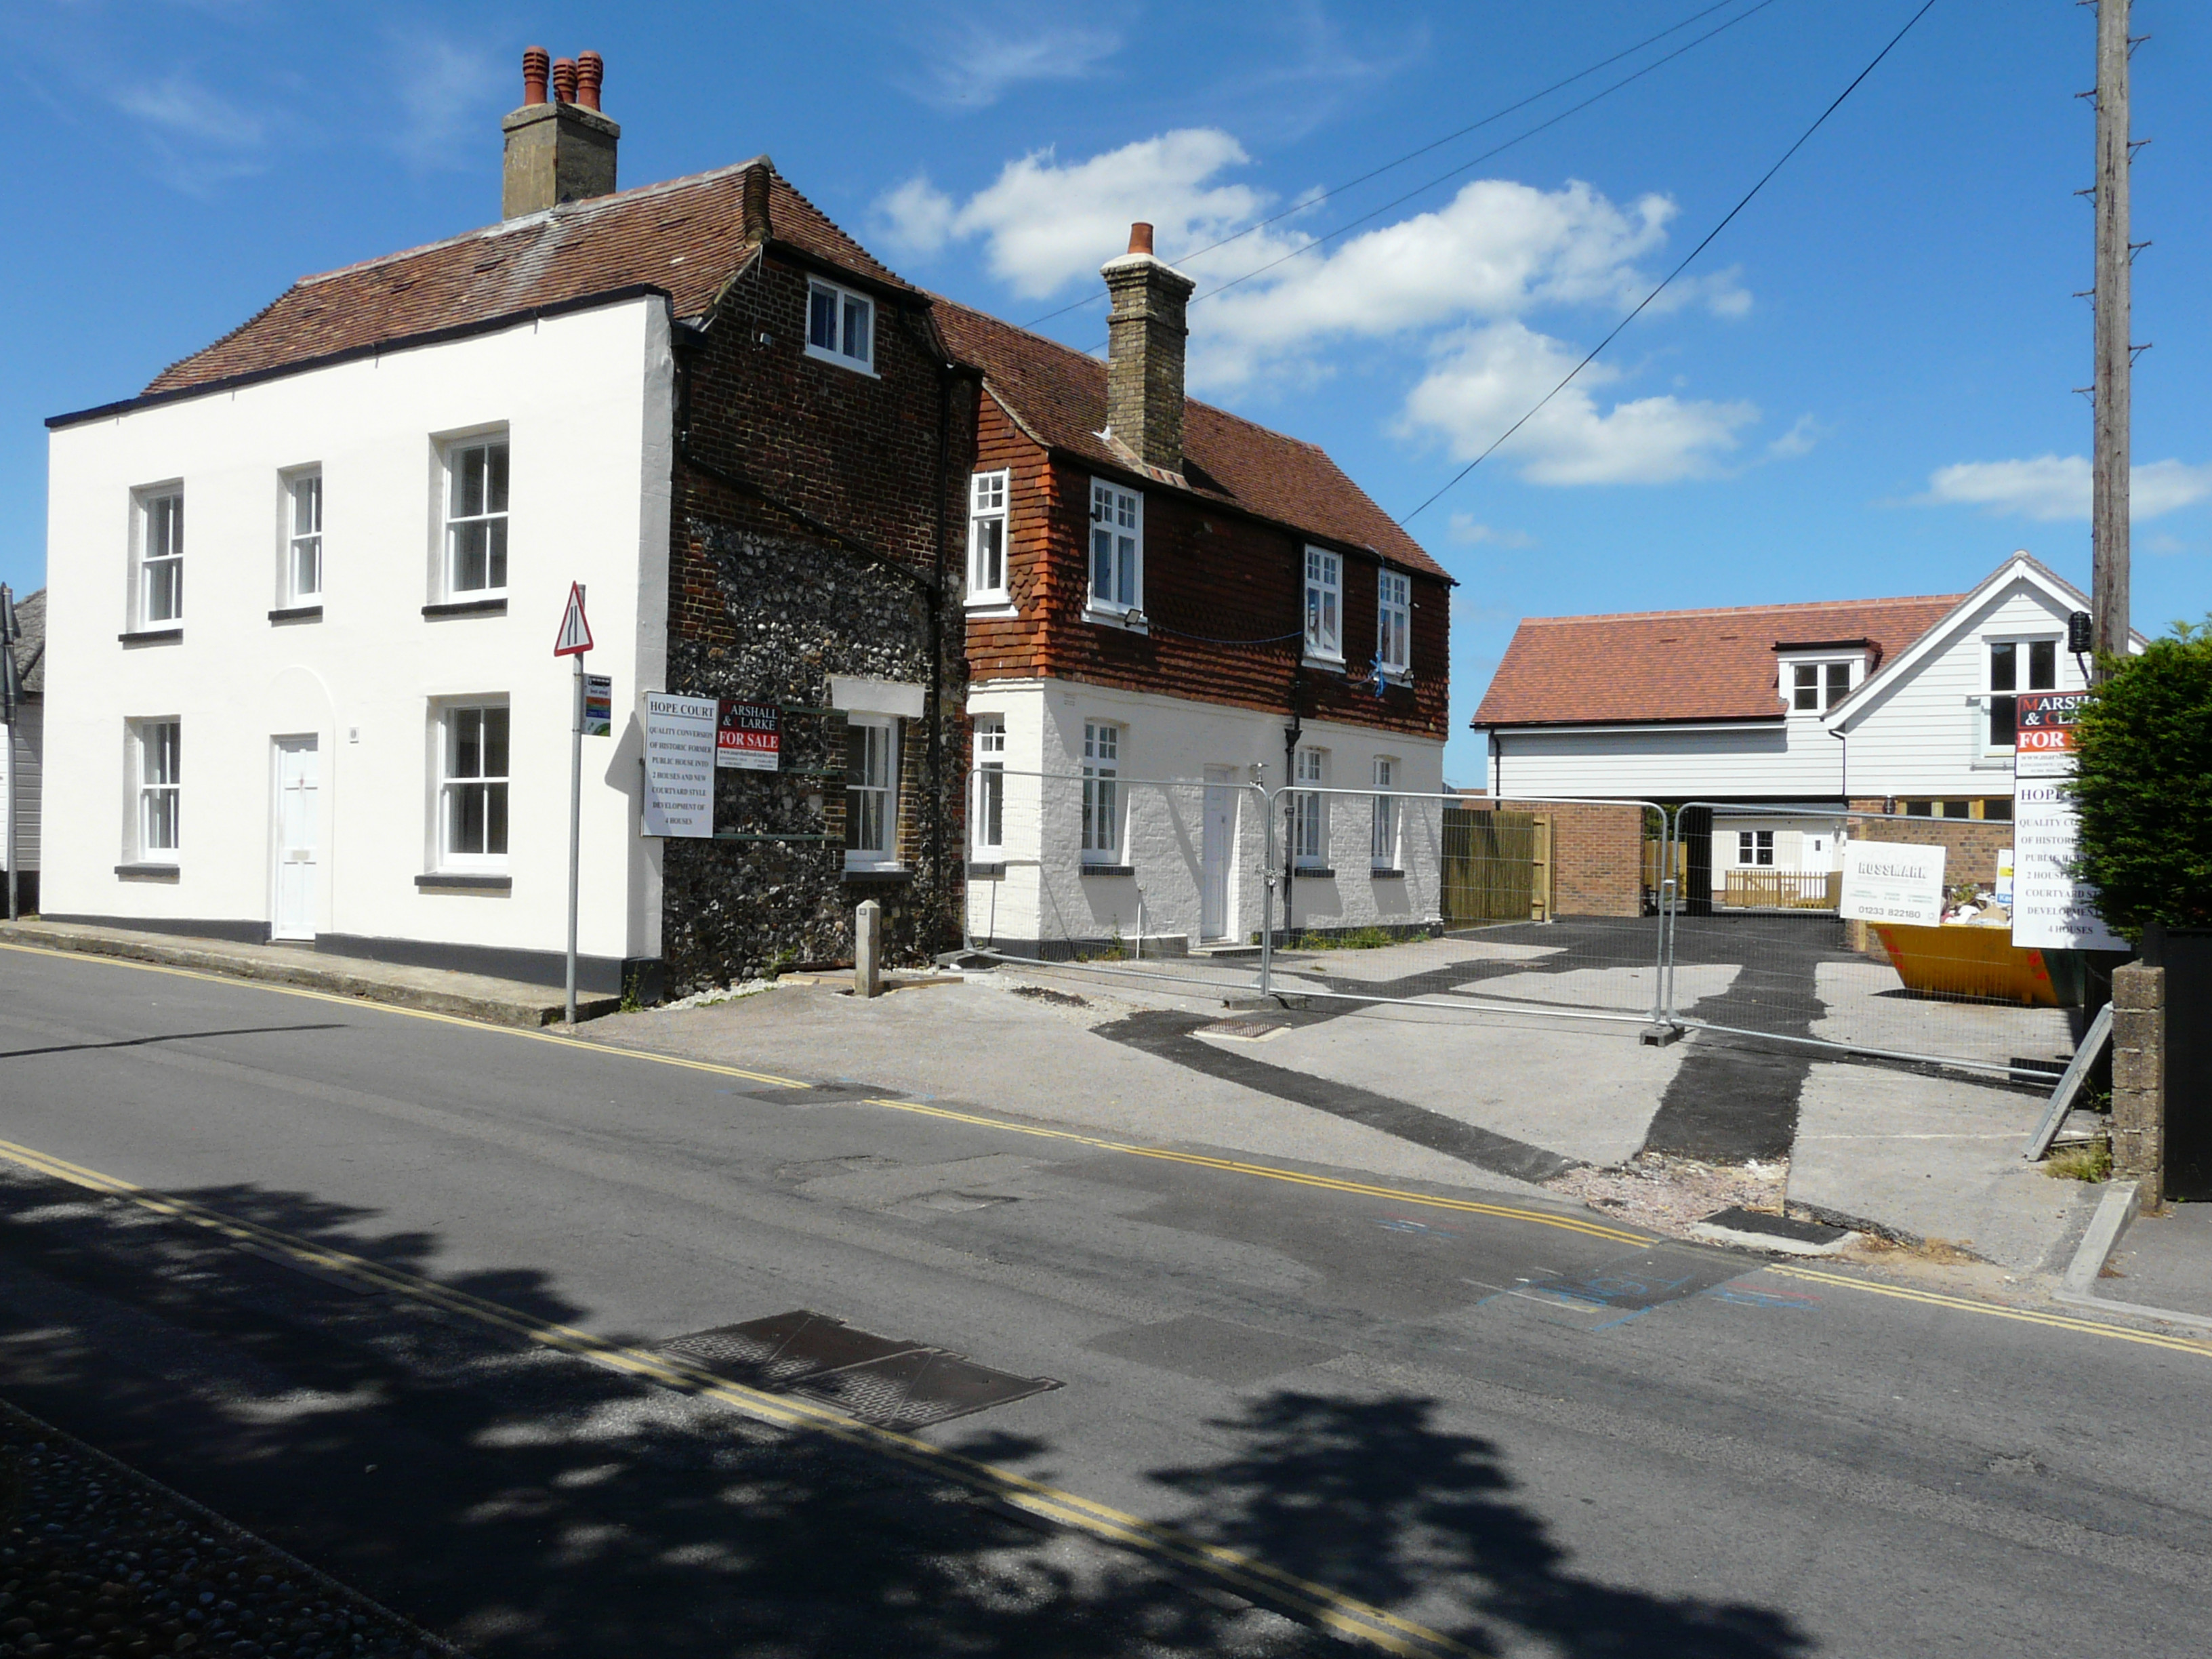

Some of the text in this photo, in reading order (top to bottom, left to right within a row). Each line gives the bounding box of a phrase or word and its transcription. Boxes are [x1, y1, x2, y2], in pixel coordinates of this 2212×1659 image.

[2022, 695, 2100, 711] MARSH
[651, 701, 714, 717] HOPE COURT
[722, 703, 778, 719] MARSHALL
[722, 715, 775, 731] & CLARKE
[2025, 710, 2081, 725] & CLA
[649, 726, 713, 739] QUALITY CONVERSION
[718, 731, 778, 749] FOR SALE
[2018, 731, 2065, 748] FOR
[659, 742, 687, 752] HISTORIC
[688, 744, 712, 754] FORMER
[652, 756, 710, 768] PUBLIC HOUSE INTO
[657, 772, 680, 780] HOUSES
[651, 786, 707, 796] COURTYARD STYLE
[653, 801, 697, 811] DEVELOPMENT
[670, 817, 693, 825] HOUSES
[2020, 818, 2061, 827] QUALITY
[2020, 836, 2076, 845] OF HISTORI
[2025, 853, 2060, 862] PUBLIC
[2026, 871, 2032, 880] 2
[2025, 888, 2085, 899] COURTYARD
[1858, 905, 1921, 919] 01233 822180
[2027, 906, 2101, 916] DEVELOPMENT
[2055, 925, 2093, 935] HOUSES
